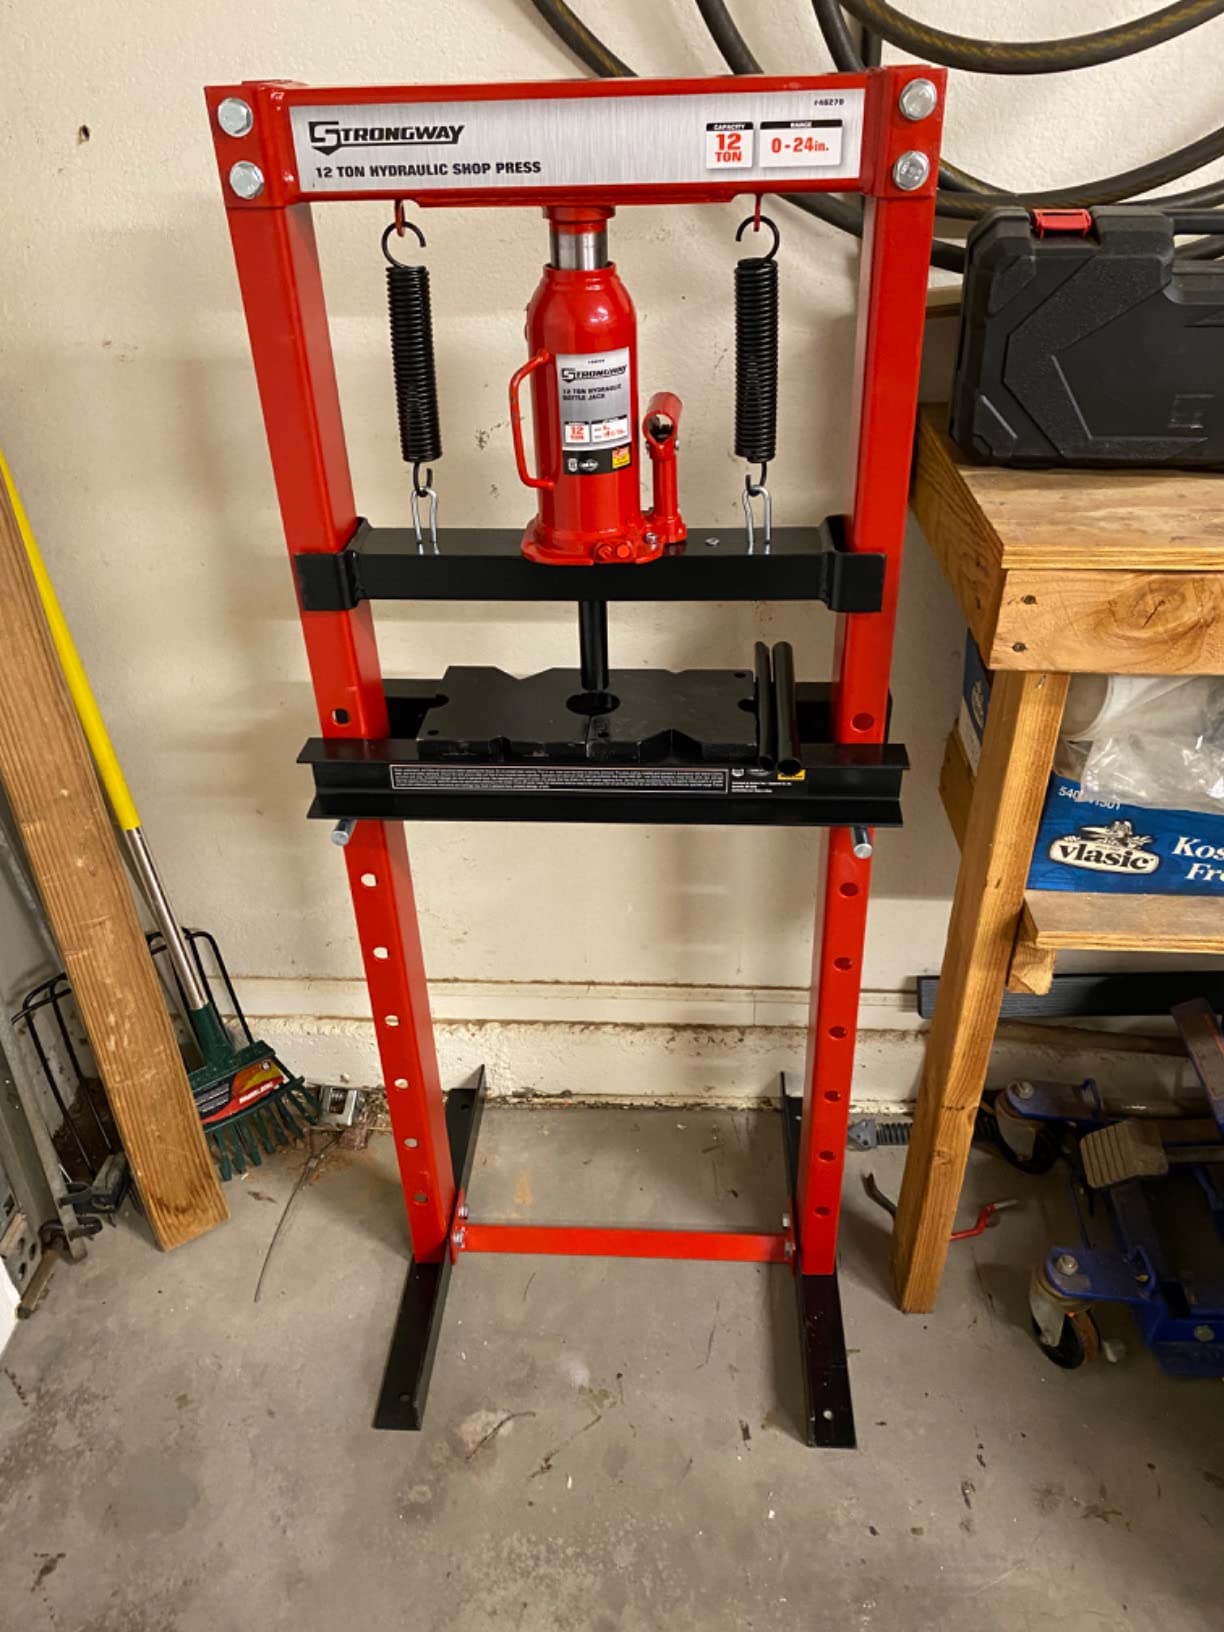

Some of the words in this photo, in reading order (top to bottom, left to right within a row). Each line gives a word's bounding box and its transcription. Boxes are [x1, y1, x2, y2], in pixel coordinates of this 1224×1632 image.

[308, 121, 465, 155] STRONGWAY
[715, 132, 742, 151] 12
[715, 151, 743, 163] TON
[316, 167, 333, 179] 12
[337, 165, 366, 178] TON
[370, 163, 448, 177] HYDRAULIC
[452, 162, 491, 175] SHOP
[496, 161, 542, 174] PRESS
[571, 426, 584, 434] 12
[1059, 843, 1150, 871] vlasic
